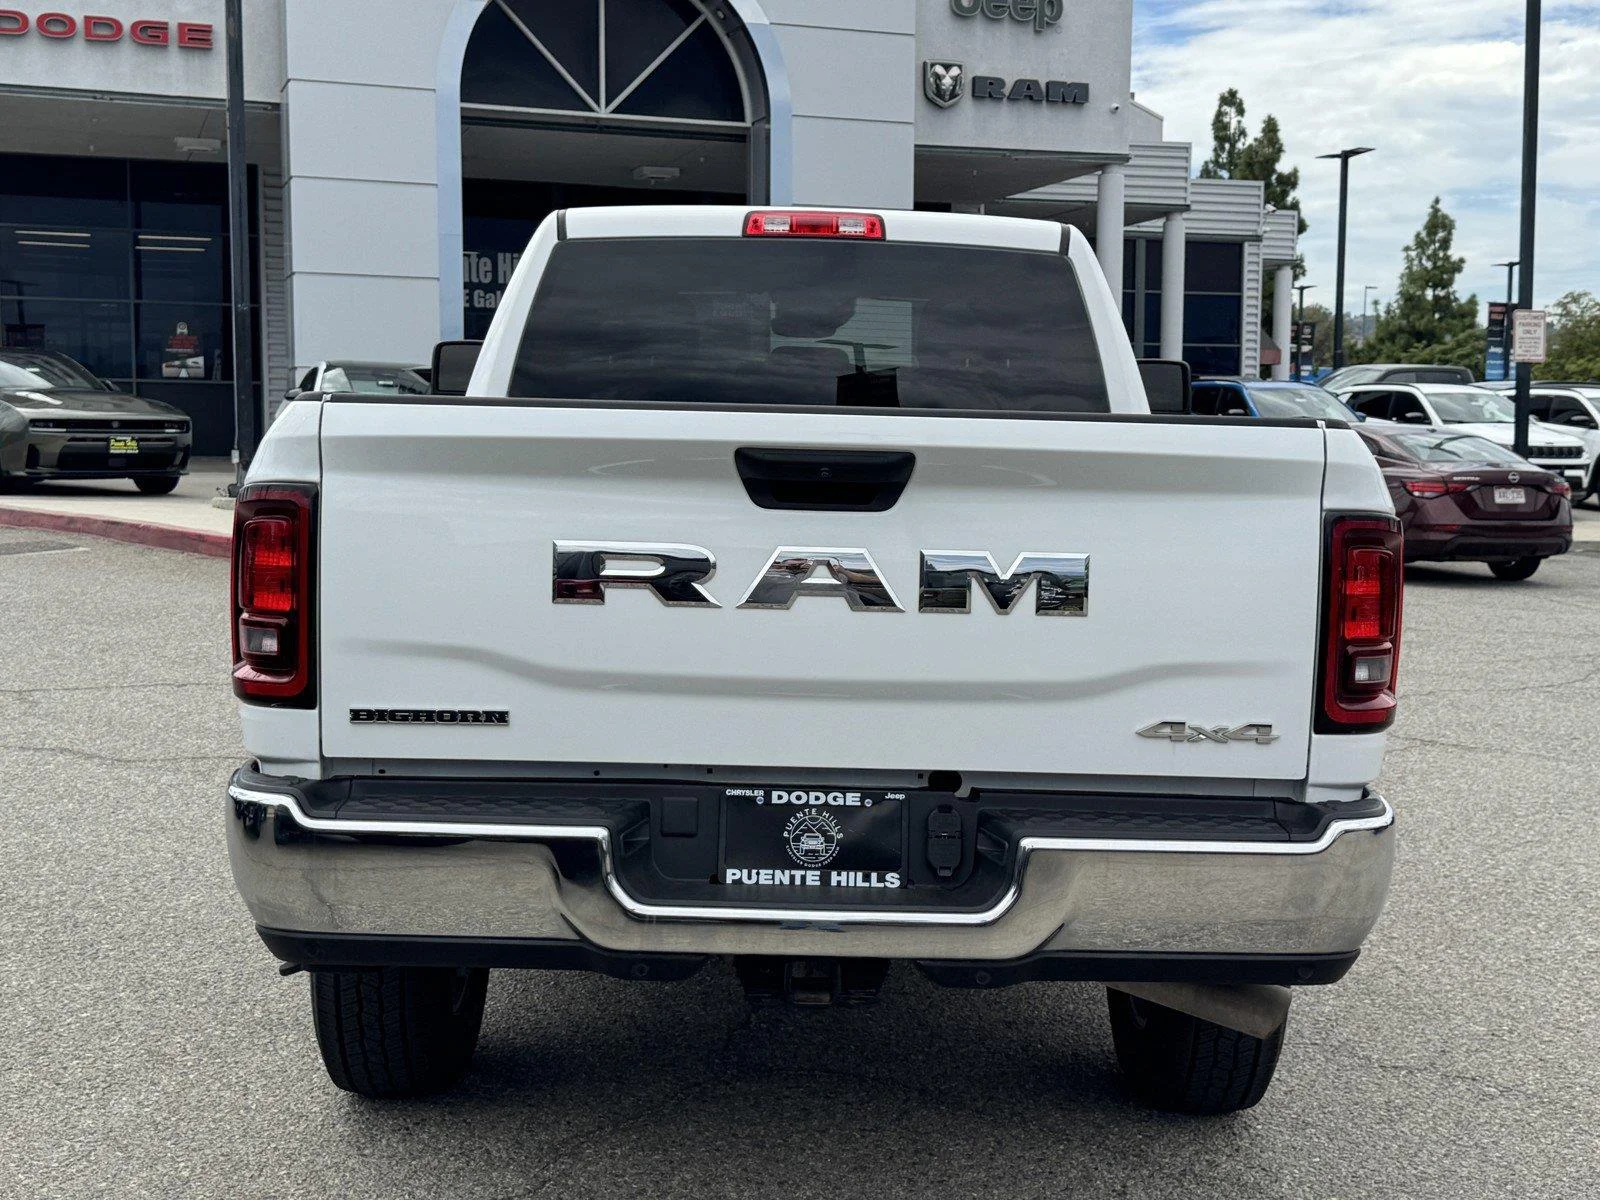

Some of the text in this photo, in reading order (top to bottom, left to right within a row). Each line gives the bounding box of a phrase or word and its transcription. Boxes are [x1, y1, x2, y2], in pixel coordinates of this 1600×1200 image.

[0, 9, 213, 49] DODGE
[972, 75, 1090, 104] RAM
[552, 539, 1091, 616] RAM
[350, 708, 510, 725] BIGHORN
[725, 789, 765, 797] CHRYSLER
[771, 790, 861, 806] DODGE
[884, 792, 906, 800] Jeep
[783, 808, 844, 840] PUENTE HILLS
[725, 868, 901, 889] PUENTE HILLS
